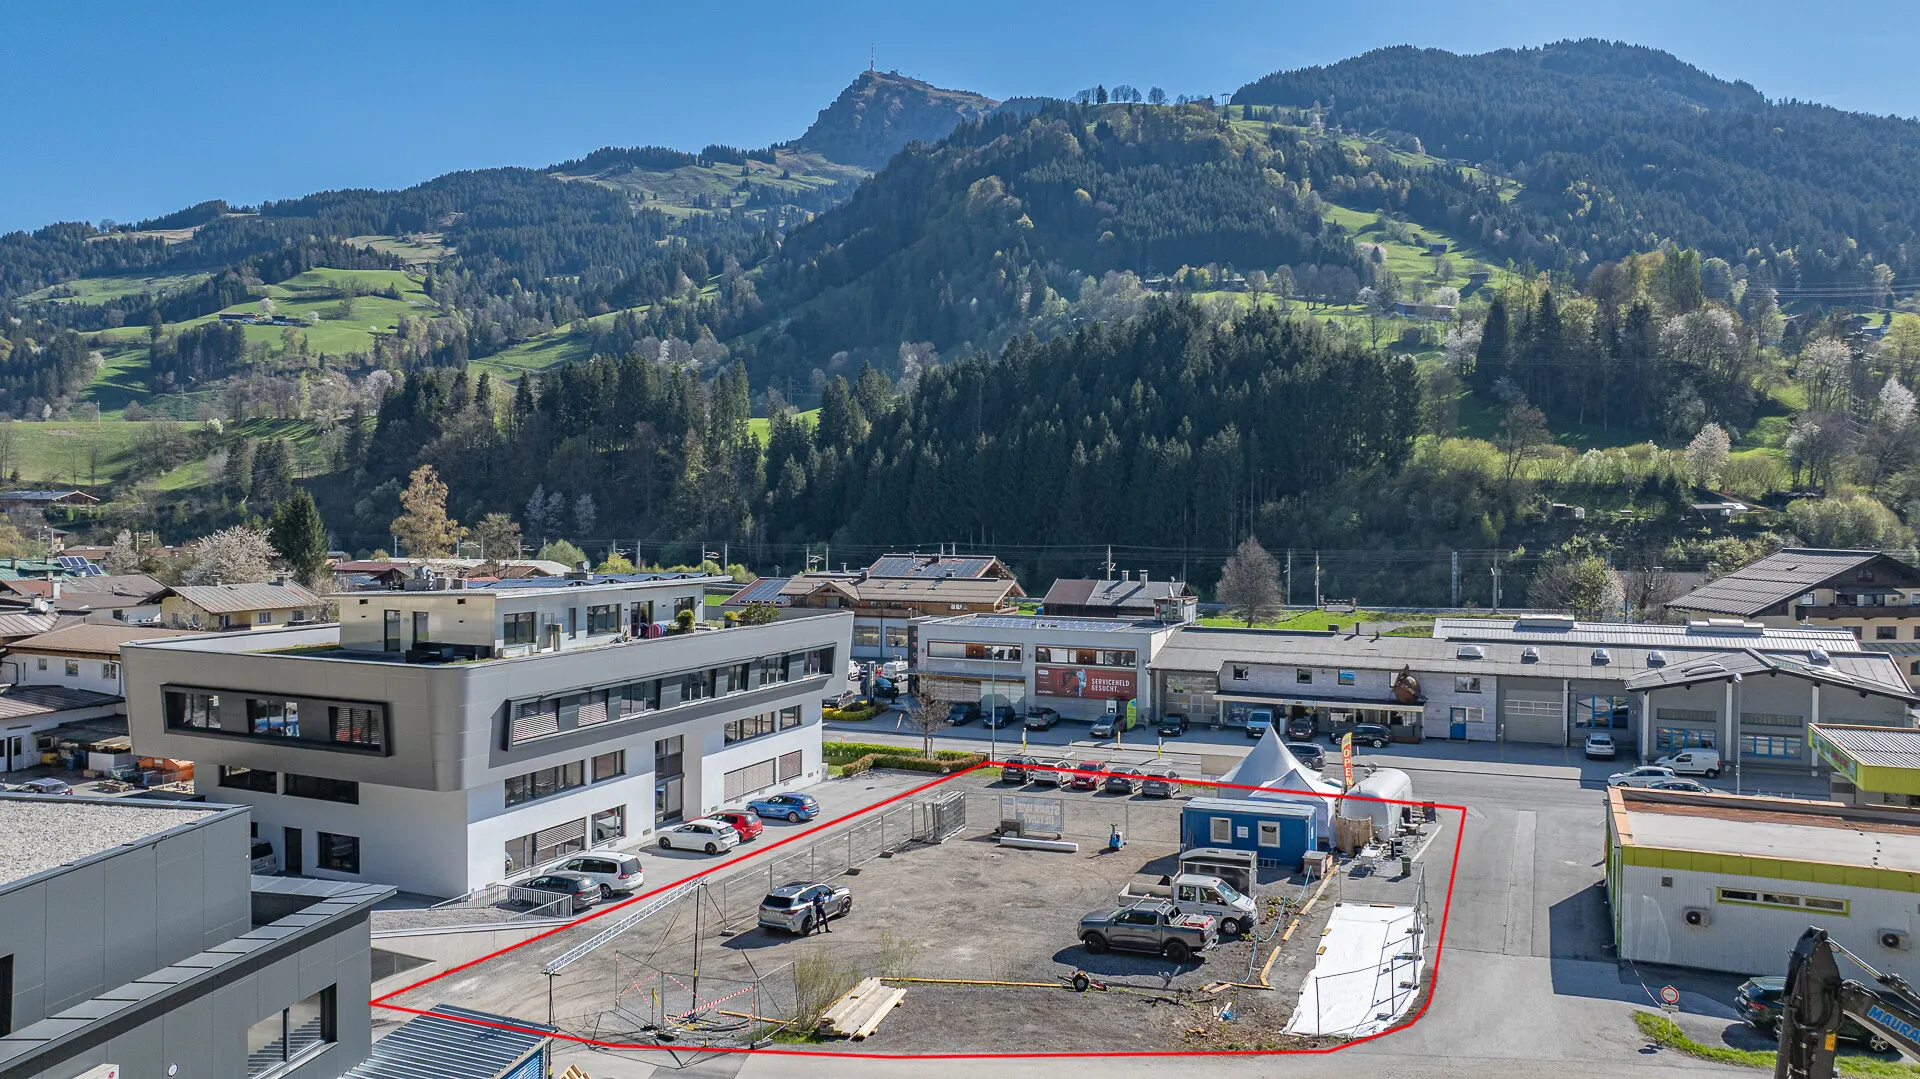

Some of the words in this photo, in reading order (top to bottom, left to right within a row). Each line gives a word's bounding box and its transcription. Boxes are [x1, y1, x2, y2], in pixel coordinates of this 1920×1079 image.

[1091, 678, 1130, 687] SERVICEHELD
[1091, 684, 1120, 693] GESUCHT.
[1343, 748, 1355, 787] OPEN
[1867, 1004, 1920, 1047] MAURA
